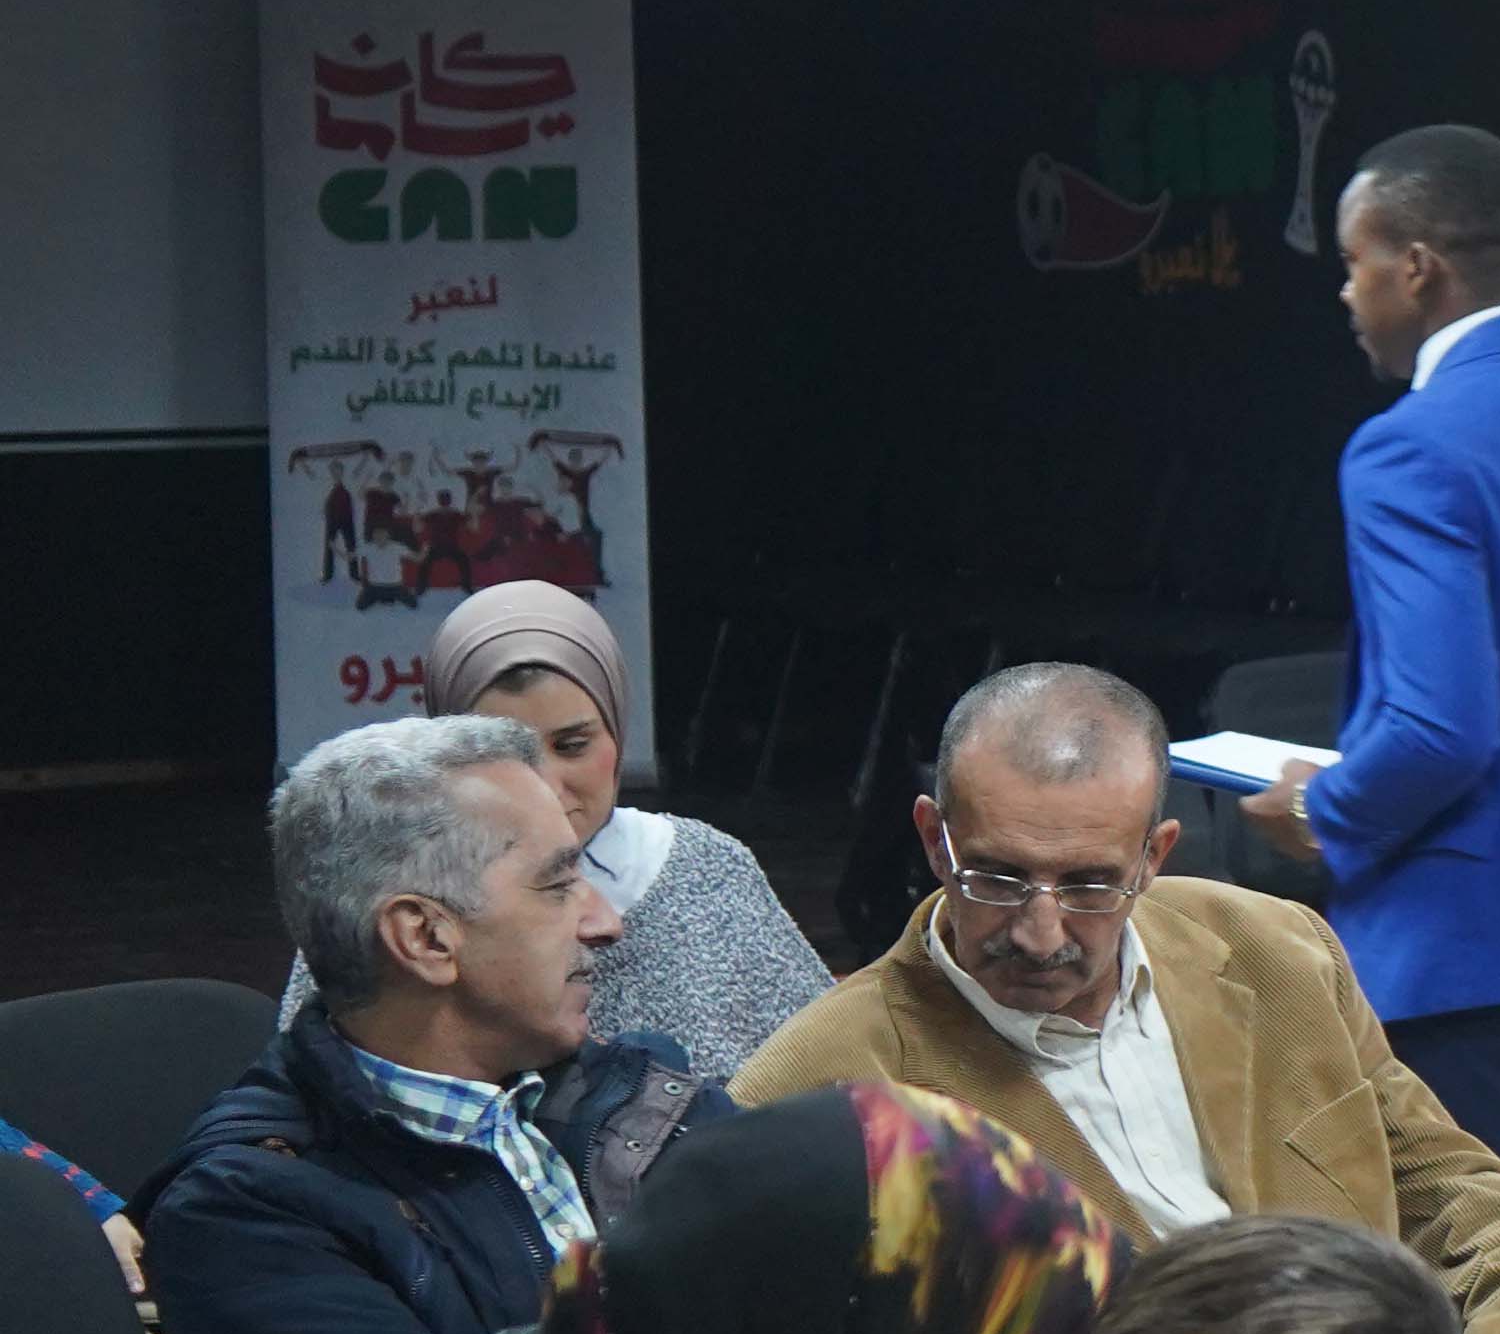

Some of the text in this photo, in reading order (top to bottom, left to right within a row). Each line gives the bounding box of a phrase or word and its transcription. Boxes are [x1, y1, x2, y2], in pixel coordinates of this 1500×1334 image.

[315, 32, 575, 112] كان
[319, 165, 578, 243] CAN
[290, 335, 616, 381] عندما تلهم كرة القدم
